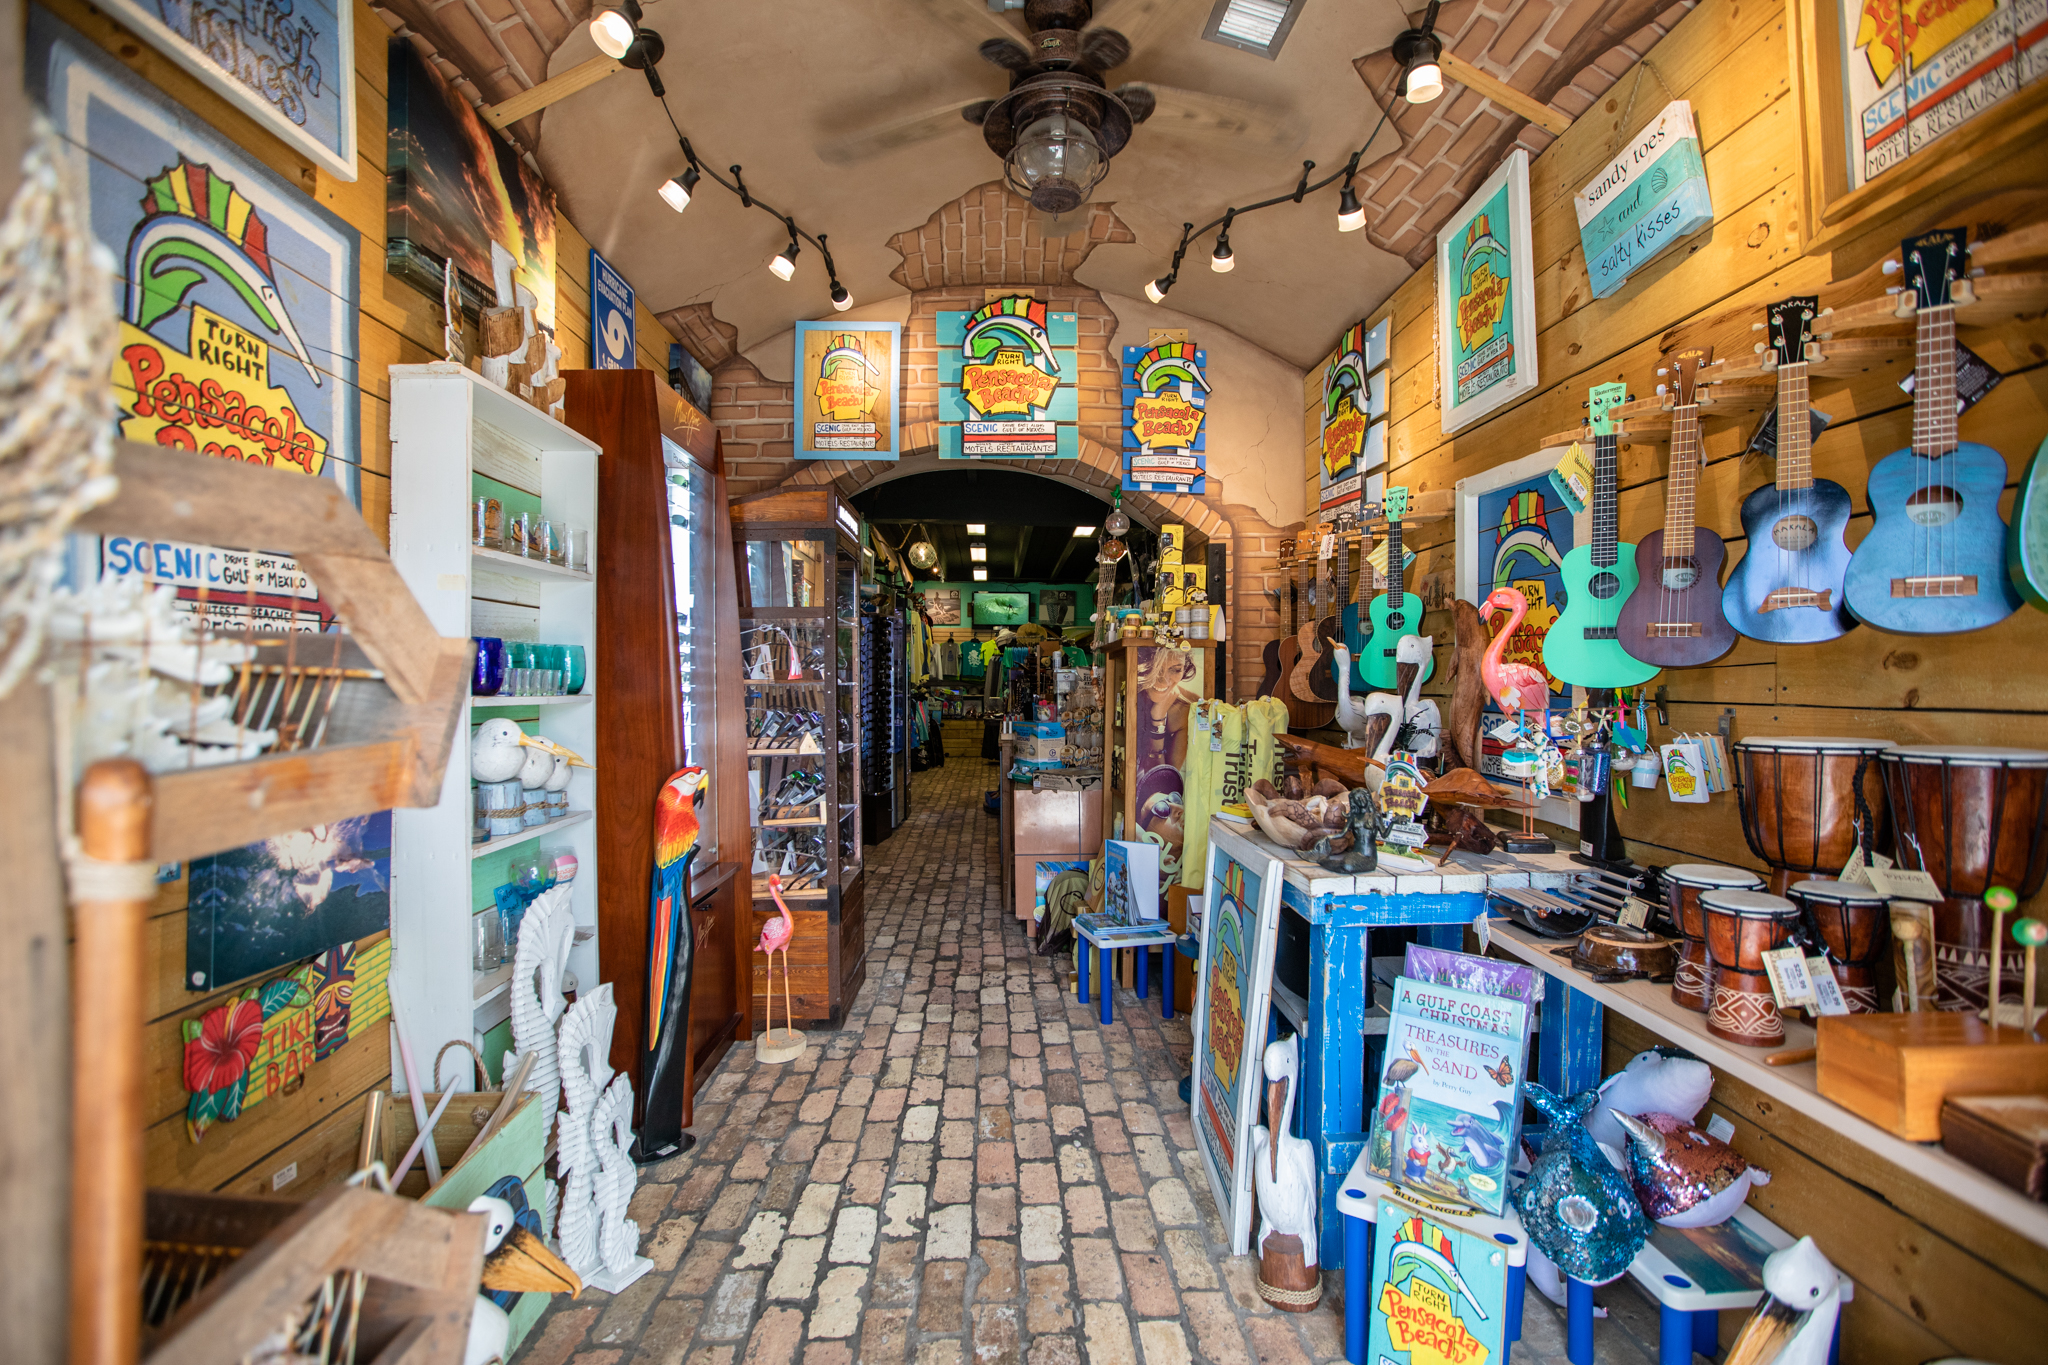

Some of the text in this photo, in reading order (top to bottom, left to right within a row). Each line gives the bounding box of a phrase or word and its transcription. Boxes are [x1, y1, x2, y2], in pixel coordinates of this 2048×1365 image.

[1866, 62, 1942, 135] SCENIC
[1588, 126, 1666, 207] sandy toes
[1868, 132, 1922, 177] MOTELS
[1618, 184, 1643, 223] and
[1601, 200, 1681, 277] salty kisses
[602, 267, 629, 303] HURRICANE
[597, 278, 632, 321] EVACUATION PLAN
[1460, 276, 1504, 326] Pensacola
[1772, 300, 1815, 314] MAKALA
[1464, 302, 1498, 343] Beach
[203, 318, 260, 358] TURN
[198, 338, 264, 381] RIGHT
[1678, 350, 1704, 359] KALA
[966, 367, 1053, 391] Pensacola
[1458, 357, 1477, 379] SCENIC
[820, 380, 874, 396] Pensacola
[977, 385, 1039, 409] Beach
[1594, 386, 1622, 396] Waterman
[121, 343, 316, 474] Pensacola
[826, 395, 863, 409] Beach
[1136, 403, 1199, 421] Pensacola
[816, 423, 841, 433] SCENIC
[965, 423, 998, 433] SCENIC
[1142, 420, 1193, 437] Beach
[1325, 412, 1364, 454] Pensacola
[965, 445, 994, 453] MOTELS
[996, 444, 1054, 453] RESTAURANTS
[1329, 433, 1357, 470] Beach
[1133, 457, 1155, 466] SCENIC
[1154, 474, 1193, 483] RESTAURANTS
[1773, 524, 1815, 536] MAKALA
[108, 537, 221, 582] SCENIC
[223, 553, 308, 574] DRIVE EAST ALO
[223, 566, 250, 585] GULF
[268, 572, 307, 589] MEXICO
[190, 602, 297, 623] WHITEST BEACHES
[1222, 752, 1242, 806] Trust
[1385, 797, 1418, 810] Beach
[1401, 990, 1512, 1025] A GULF COAST
[263, 1008, 311, 1059] TIKI
[1405, 1023, 1500, 1060] TREASURES
[1425, 1045, 1450, 1057] IN THE
[266, 1042, 315, 1096] BAR
[1431, 1057, 1478, 1080] SAND
[1432, 1080, 1473, 1096] by Perry Guy
[1394, 1189, 1474, 1217] BLUE ANGELS
[1413, 1290, 1449, 1313] RIGHT
[1414, 1281, 1446, 1301] TURN
[1385, 1290, 1480, 1356] Pensacola
[1396, 1320, 1467, 1364] Beach
